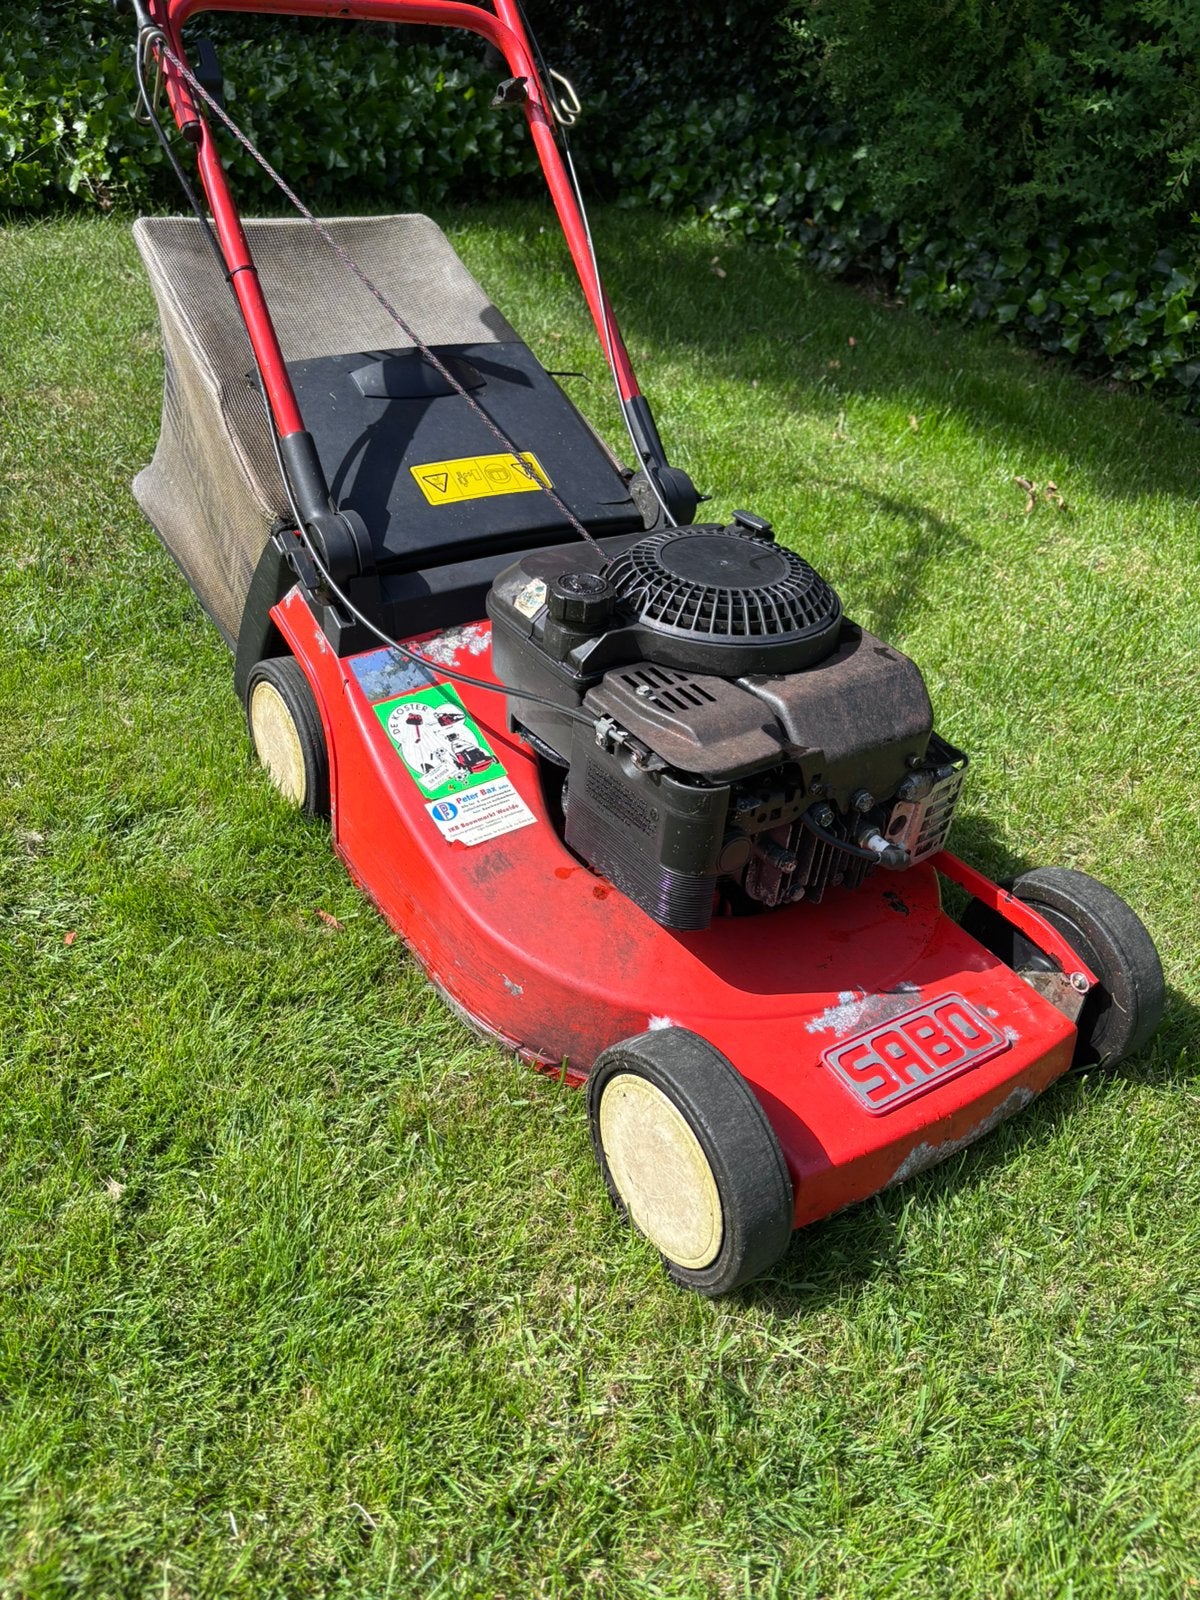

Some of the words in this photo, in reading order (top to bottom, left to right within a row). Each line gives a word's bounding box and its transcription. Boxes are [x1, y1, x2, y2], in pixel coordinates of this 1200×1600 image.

[392, 703, 428, 720] KOSTER
[390, 723, 401, 735] DE
[456, 792, 478, 804] Peter
[479, 786, 496, 796] Bax
[460, 812, 496, 828] Bouwmarkt
[838, 1003, 993, 1102] SABO
